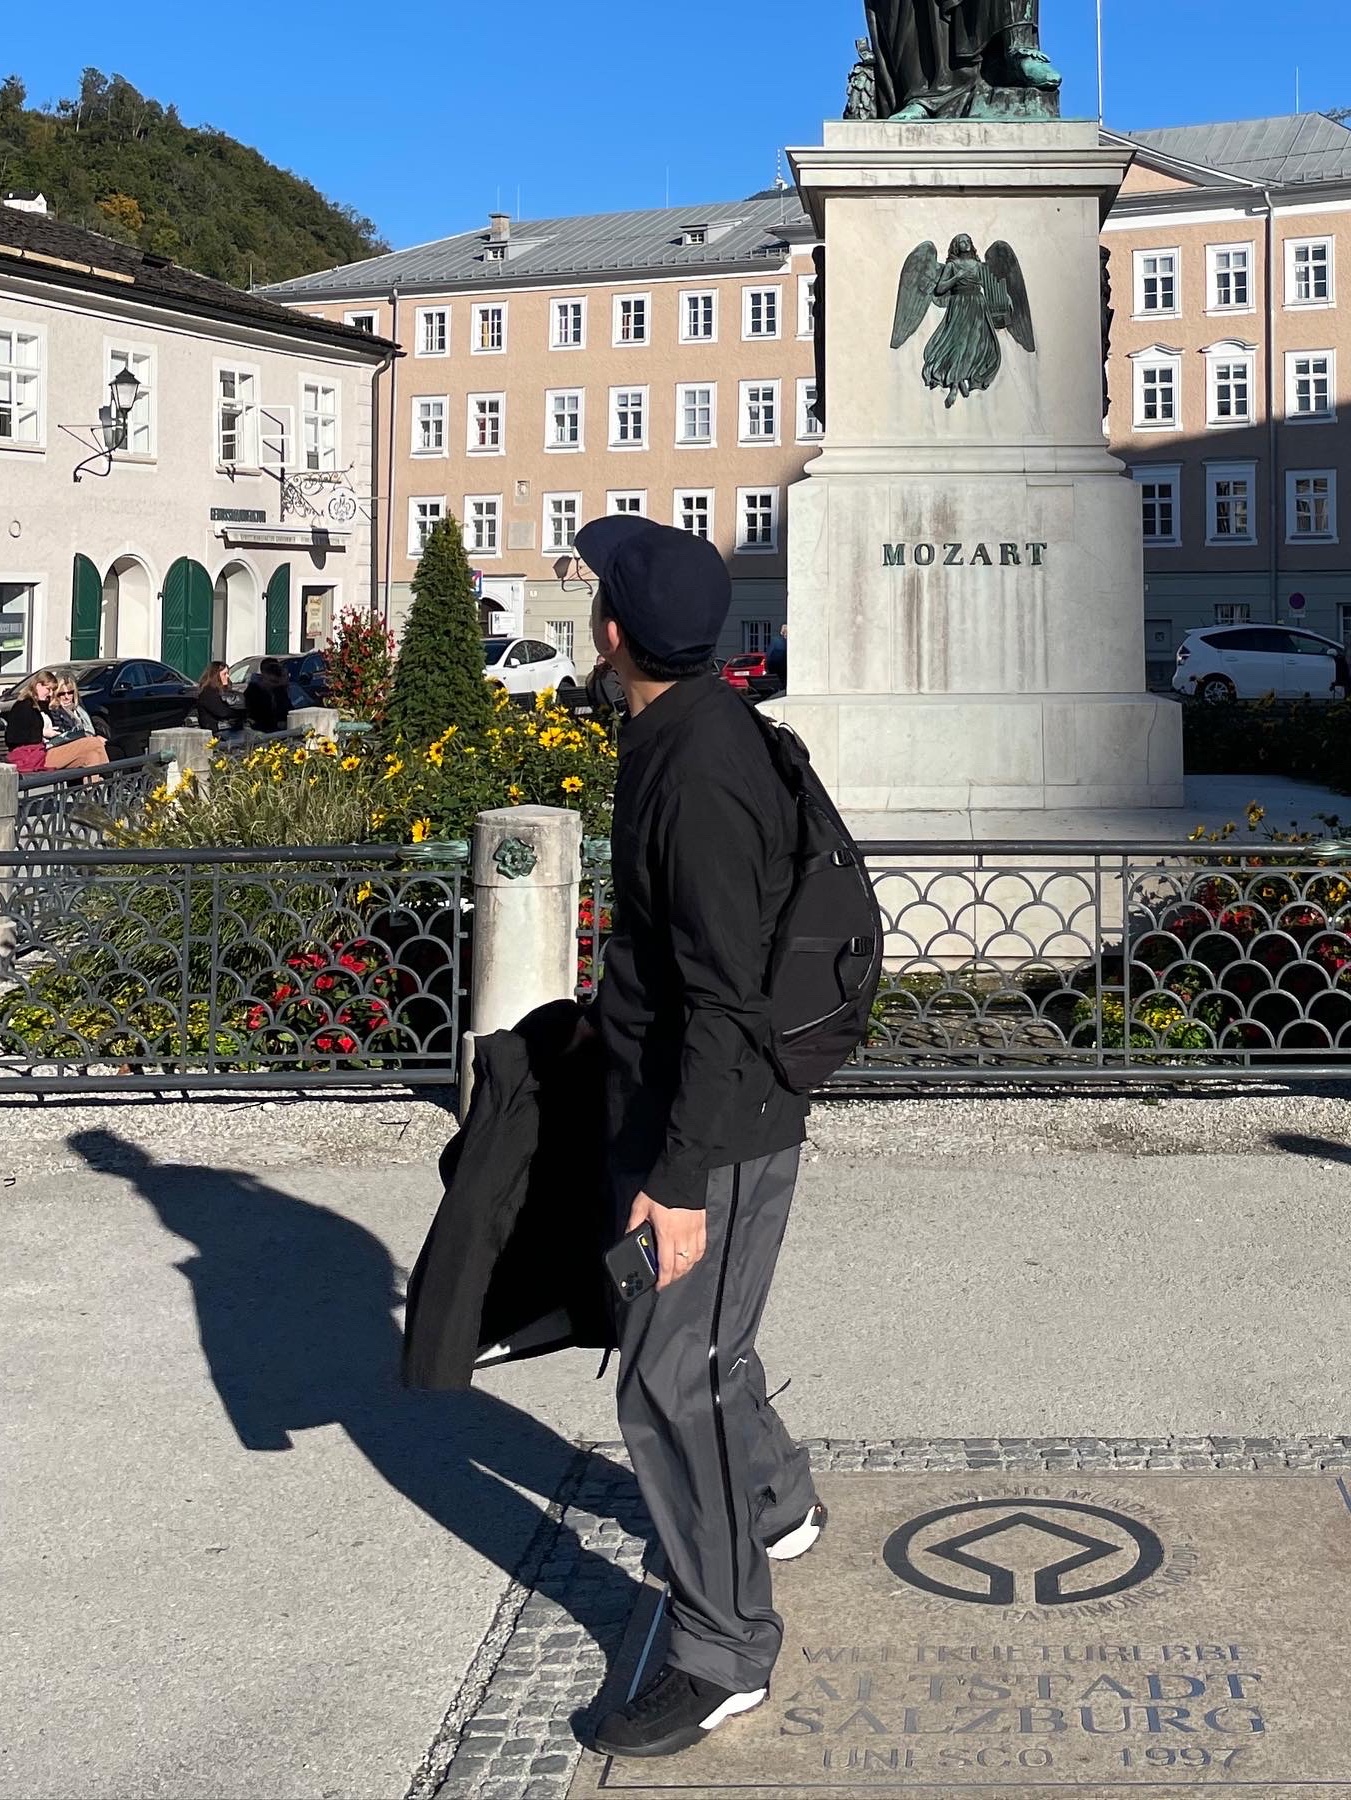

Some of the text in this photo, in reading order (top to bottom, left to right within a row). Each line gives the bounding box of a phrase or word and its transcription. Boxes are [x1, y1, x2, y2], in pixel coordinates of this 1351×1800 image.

[882, 543, 1047, 566] MOZART
[785, 1672, 1262, 1701] ALTSTADT
[779, 1705, 1266, 1735] SALZBURG
[822, 1747, 1250, 1769] UNESCO 1997
